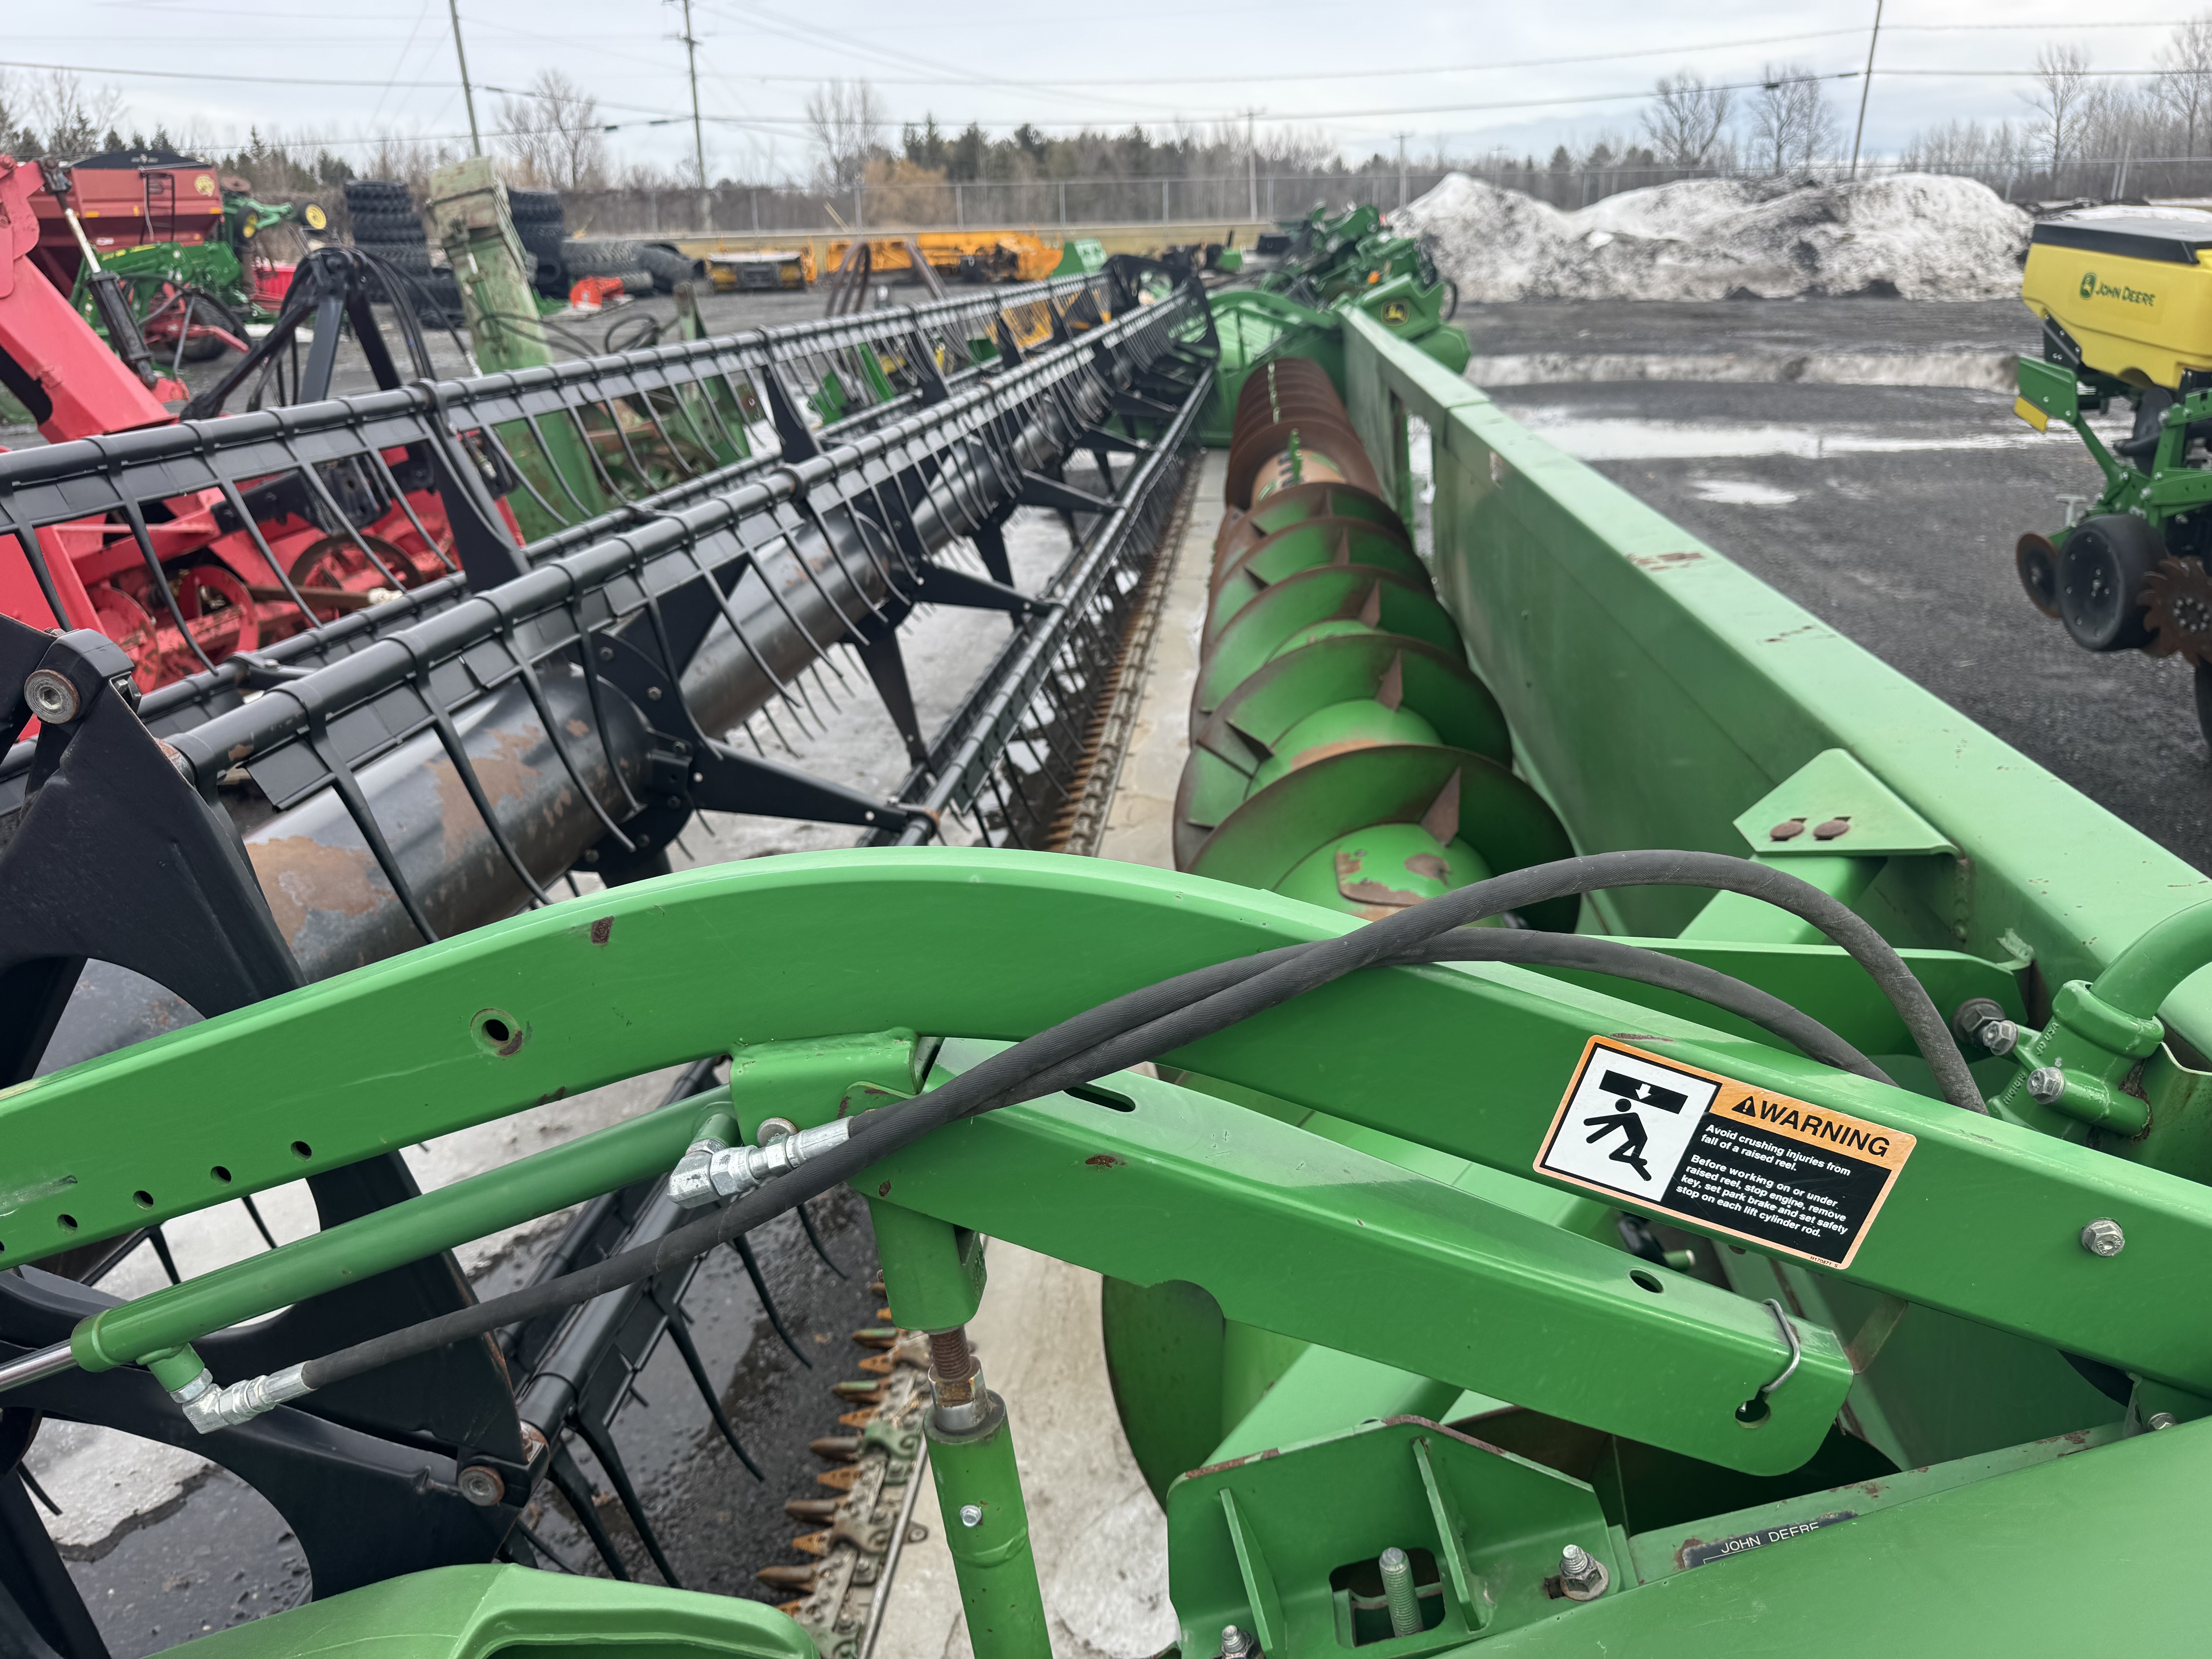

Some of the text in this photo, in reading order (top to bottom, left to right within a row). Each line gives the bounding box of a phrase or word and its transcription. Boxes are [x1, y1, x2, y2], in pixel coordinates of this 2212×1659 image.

[2095, 282, 2156, 307] JOHN DEERE
[2044, 1022, 2060, 1042] USA
[1701, 1135, 1718, 1146] fall
[1719, 1140, 1732, 1150] of
[1741, 1148, 1774, 1163] raised
[1775, 1158, 1796, 1171] reel.
[1705, 1125, 1851, 1176] Avoid crushing injuries from
[1760, 1100, 1890, 1158] WARNING
[1681, 1174, 1848, 1235] key, set park brake and set safety
[1686, 1166, 1846, 1221] raised reel, stop engine, remove
[1691, 1154, 1838, 1207] Before working on or under
[1676, 1186, 1820, 1237] stop on each lift cylinder rod.
[1721, 1522, 1819, 1553] JOHN DEERE
